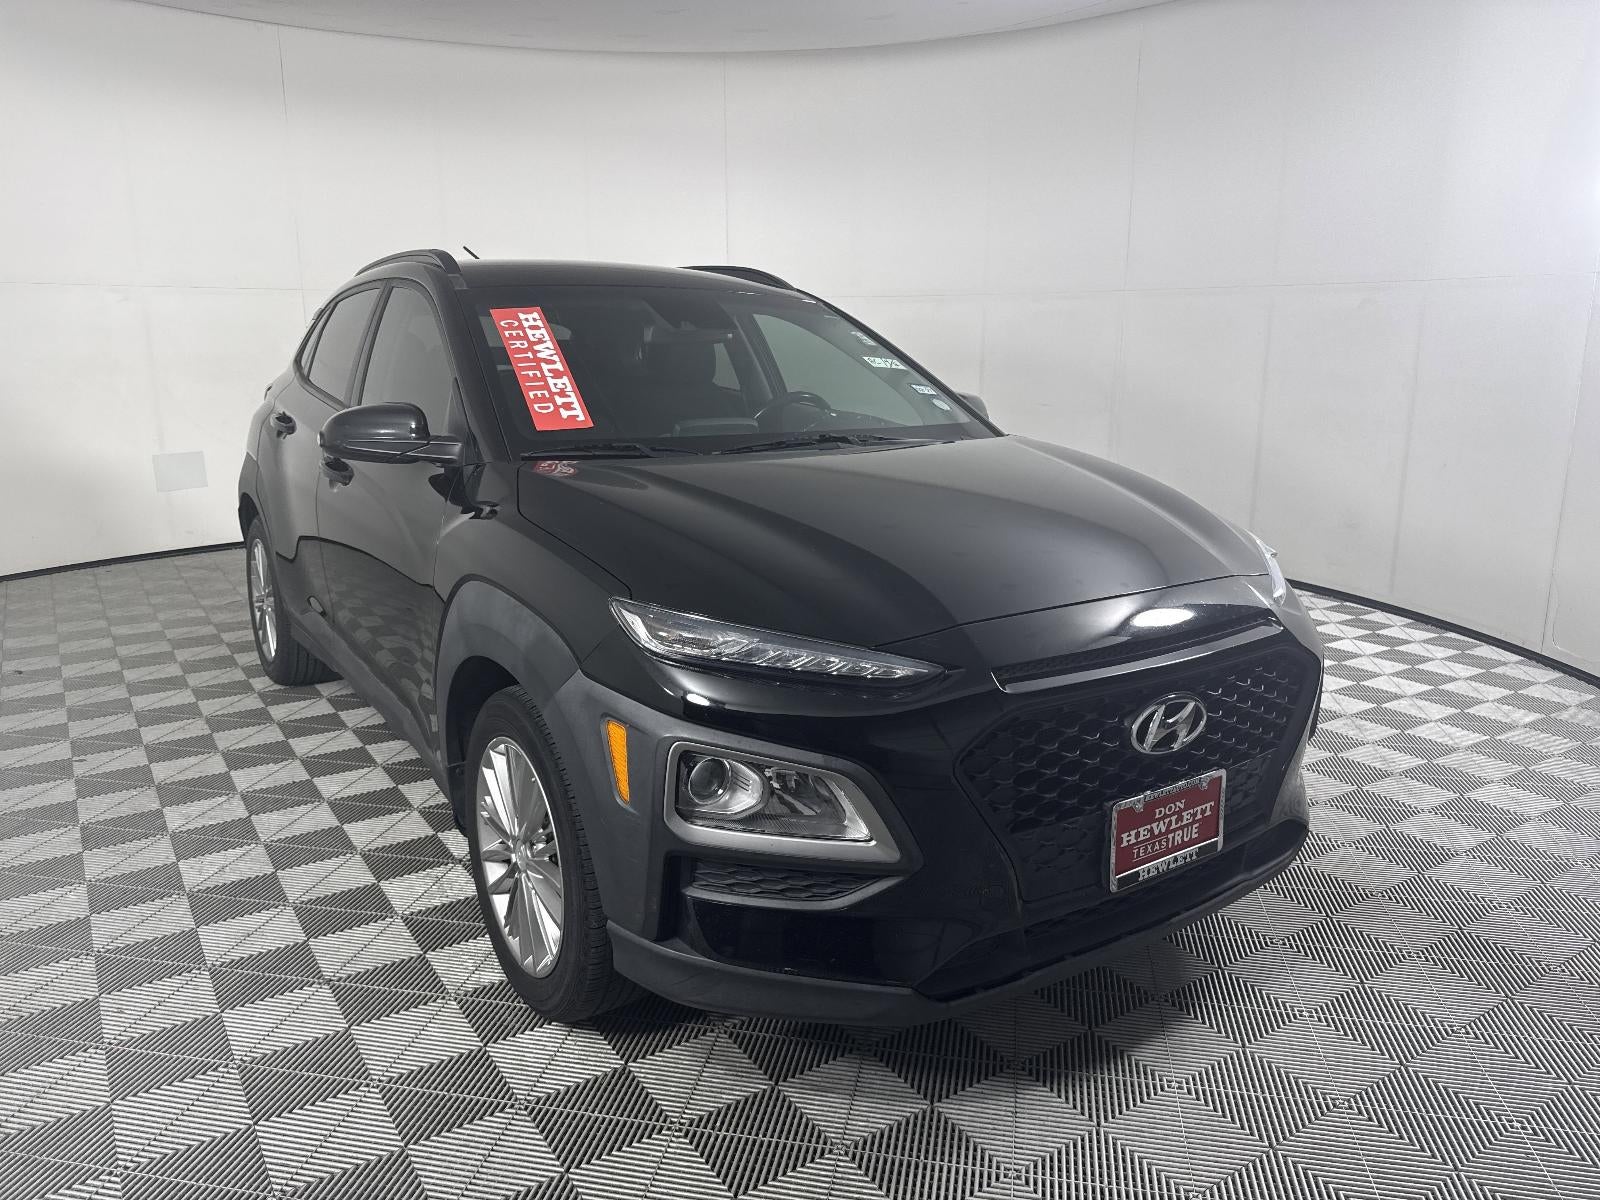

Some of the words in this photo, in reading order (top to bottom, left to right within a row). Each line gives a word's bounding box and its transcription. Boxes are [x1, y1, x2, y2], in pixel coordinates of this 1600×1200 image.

[500, 319, 555, 413] CERTIFIED
[518, 312, 586, 421] HEWLETT
[1120, 801, 1215, 848] HEWLETT
[1154, 799, 1186, 819] DON
[1138, 848, 1199, 881] HEWLETT
